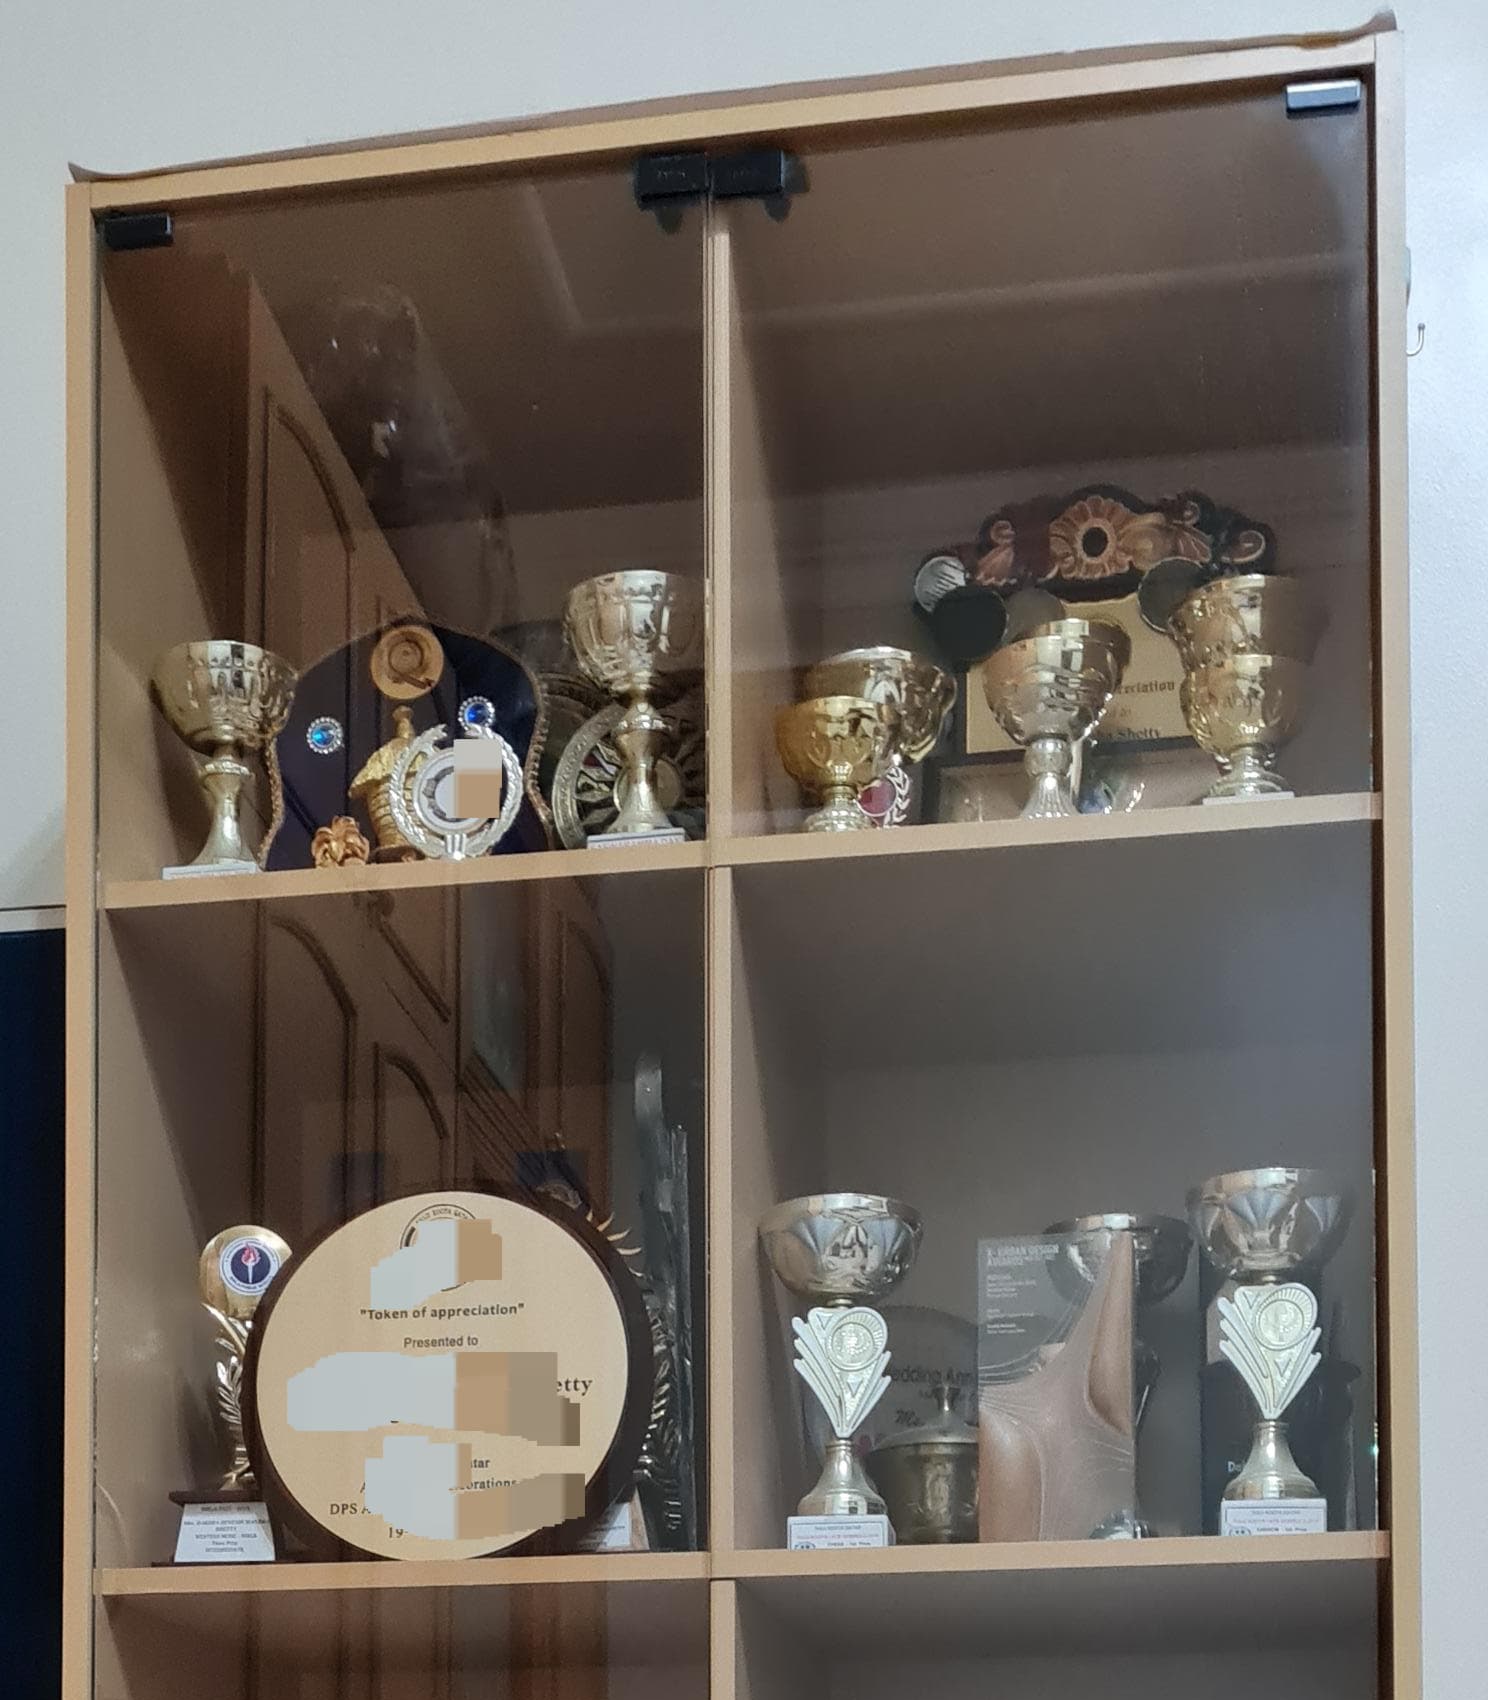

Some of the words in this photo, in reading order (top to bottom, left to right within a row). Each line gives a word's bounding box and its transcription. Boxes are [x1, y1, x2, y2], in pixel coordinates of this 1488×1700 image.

[360, 1308, 408, 1320] "Token
[412, 1306, 427, 1319] of
[430, 1302, 525, 1321] appreciation"
[403, 1336, 464, 1349] Presented
[467, 1335, 479, 1347] to
[556, 1377, 593, 1397] etty
[470, 1458, 491, 1469] tar
[330, 1503, 358, 1515] DPS
